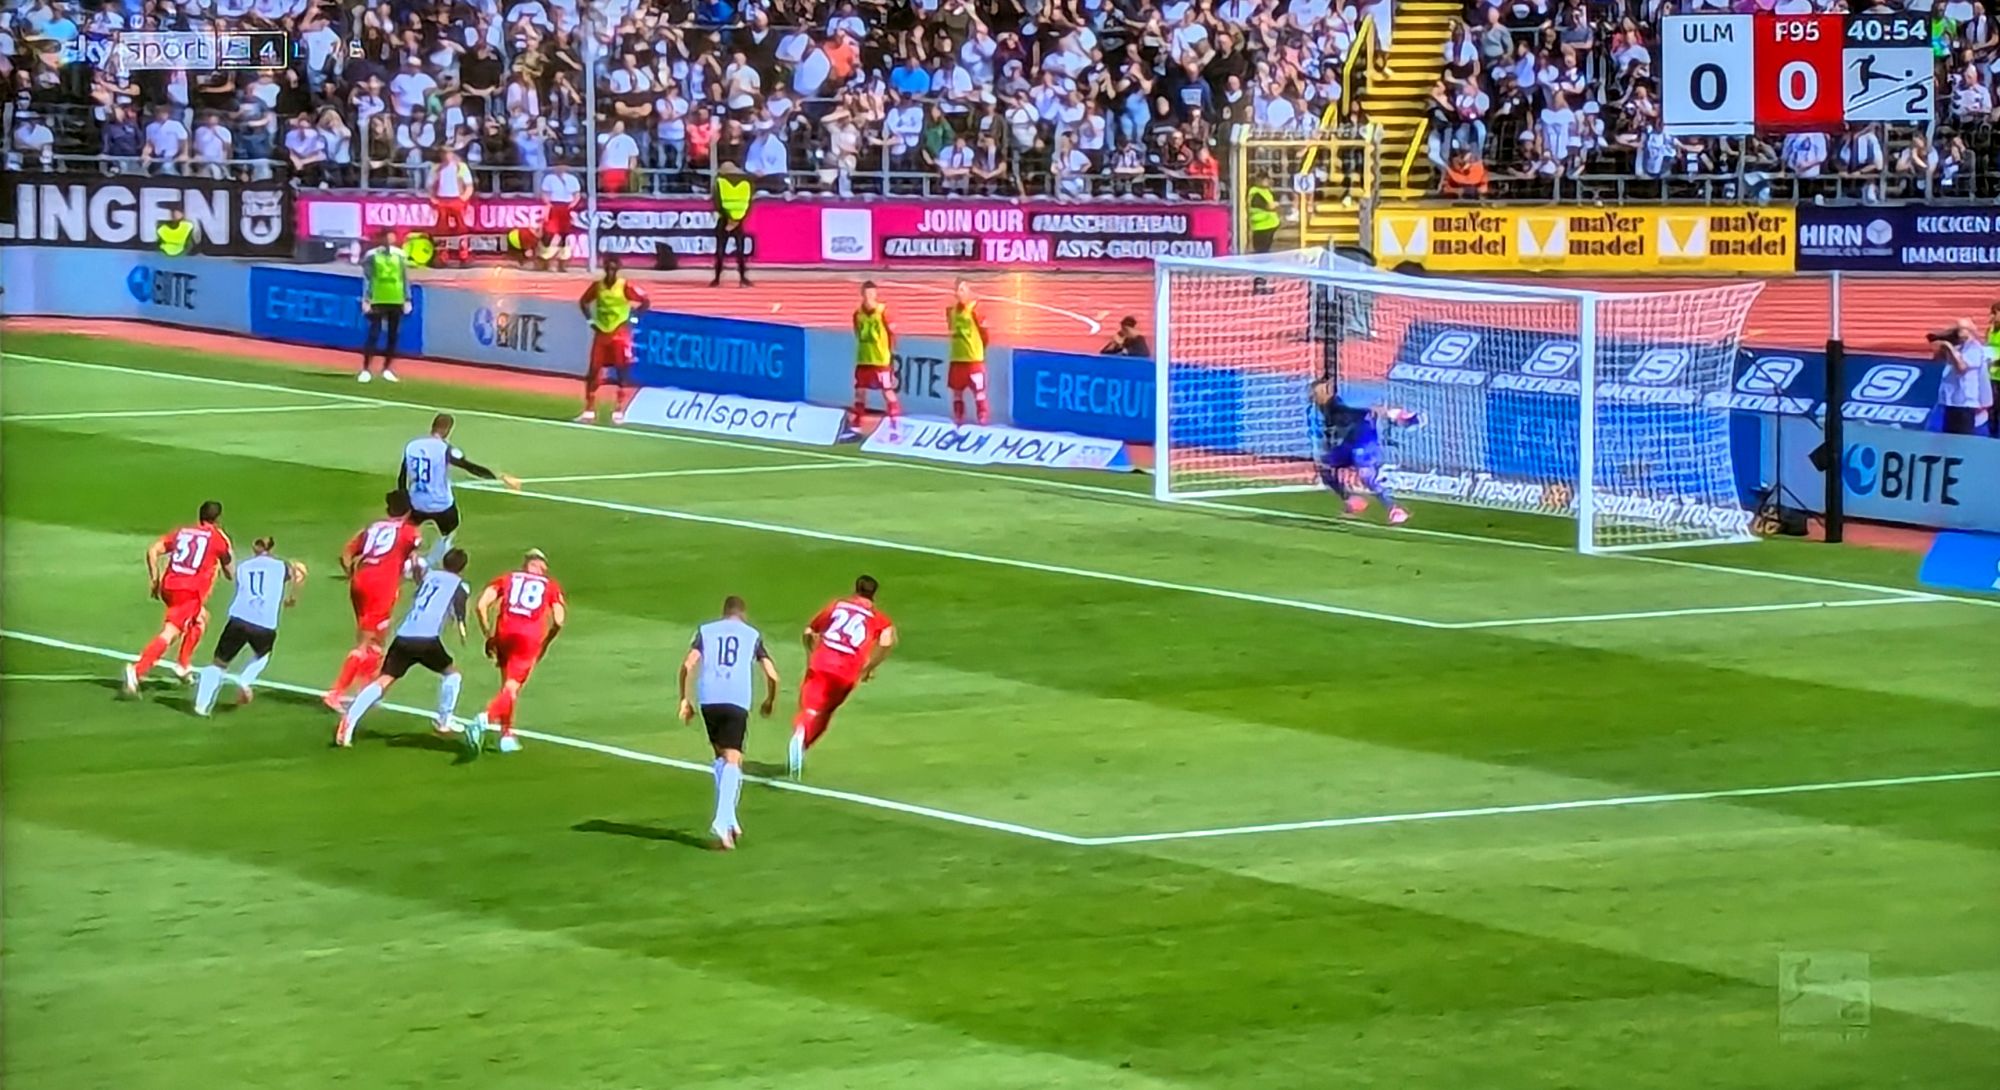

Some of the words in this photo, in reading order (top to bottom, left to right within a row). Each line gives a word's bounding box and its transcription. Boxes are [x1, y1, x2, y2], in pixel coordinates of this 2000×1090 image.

[0, 184, 230, 245] INGEN
[917, 209, 972, 233] JOIN
[974, 209, 1024, 233] OUR
[1916, 215, 1991, 233] KICKEN
[982, 239, 1049, 262] TEAM
[1056, 240, 1213, 258] ASYS-GROUP.COM
[1800, 224, 1863, 247] HIRN
[1902, 246, 2000, 264] IMMOBILI
[152, 270, 198, 310] BITE
[495, 311, 548, 353] BITE
[666, 393, 798, 433] uhlsport
[911, 425, 992, 455] LIQUI
[991, 434, 1076, 464] MOLY
[1881, 451, 1965, 506] BITE
[171, 533, 209, 570] 31
[362, 525, 397, 557] 19
[248, 570, 265, 596] 11
[508, 576, 545, 611] 18
[822, 607, 867, 648] 24
[717, 635, 740, 668] 18
